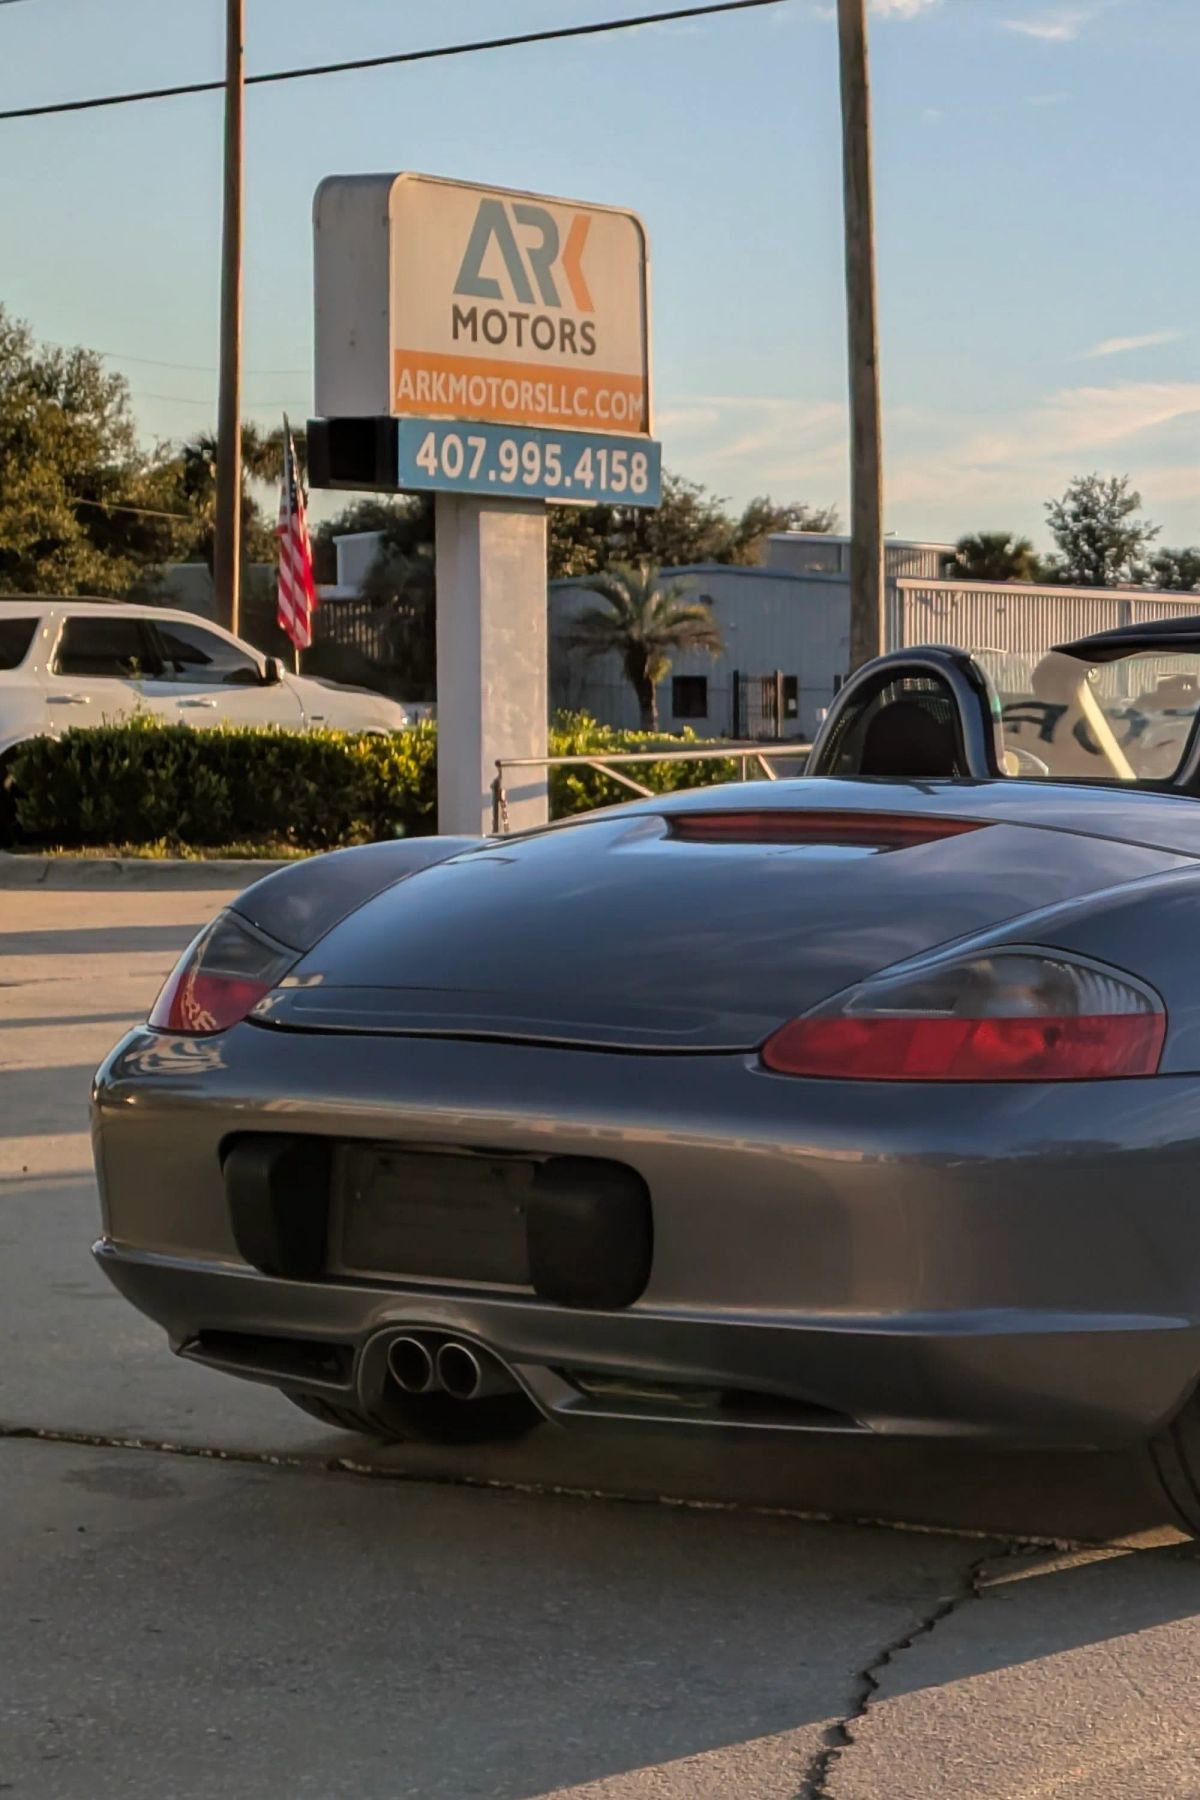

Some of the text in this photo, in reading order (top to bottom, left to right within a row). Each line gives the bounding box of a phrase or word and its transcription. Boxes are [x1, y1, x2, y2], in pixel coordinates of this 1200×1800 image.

[453, 198, 595, 313] ARK
[452, 304, 596, 356] MOTORS
[398, 368, 643, 421] ARKMOTORSLLC.COM
[416, 432, 648, 493] 407.995.4158
